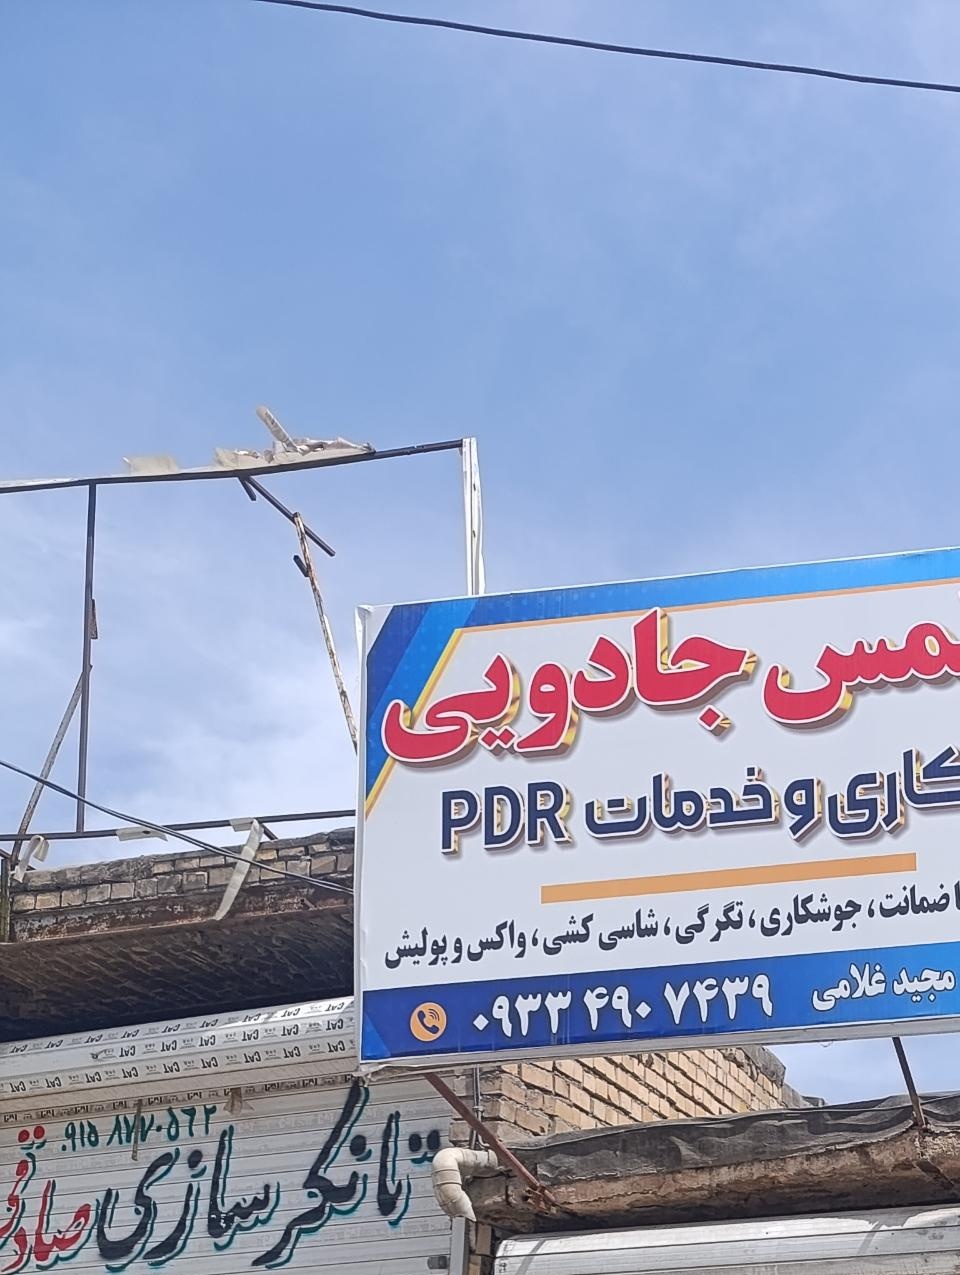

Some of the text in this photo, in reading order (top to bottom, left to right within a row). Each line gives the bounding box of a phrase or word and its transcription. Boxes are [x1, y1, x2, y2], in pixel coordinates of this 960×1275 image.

[381, 607, 756, 763] جادویی
[584, 765, 779, 839] خدمات
[440, 780, 572, 855] PDR
[467, 920, 526, 961] واکس
[385, 926, 447, 969] پولیش
[812, 962, 886, 1011] غلامی
[892, 967, 956, 1002] مجید
[473, 974, 774, 1038] ۰۹۳۳ ۴۹۰ ۷۴۳۹
[281, 1024, 299, 1037] CAT
[326, 1018, 344, 1031] CAT
[199, 1034, 216, 1047] CAT
[242, 1028, 259, 1041] CAT
[119, 1045, 136, 1057] CAT
[161, 1039, 177, 1052] CAT
[284, 1046, 301, 1058] CAT
[328, 1040, 346, 1053] CAT
[201, 1056, 218, 1069] CAT
[243, 1051, 261, 1063] CAT
[122, 1066, 138, 1078] CAT
[163, 1061, 180, 1073] CAT
[45, 1076, 62, 1088] CAT
[85, 1071, 102, 1083] CAT
[10, 1080, 26, 1092] CAT
